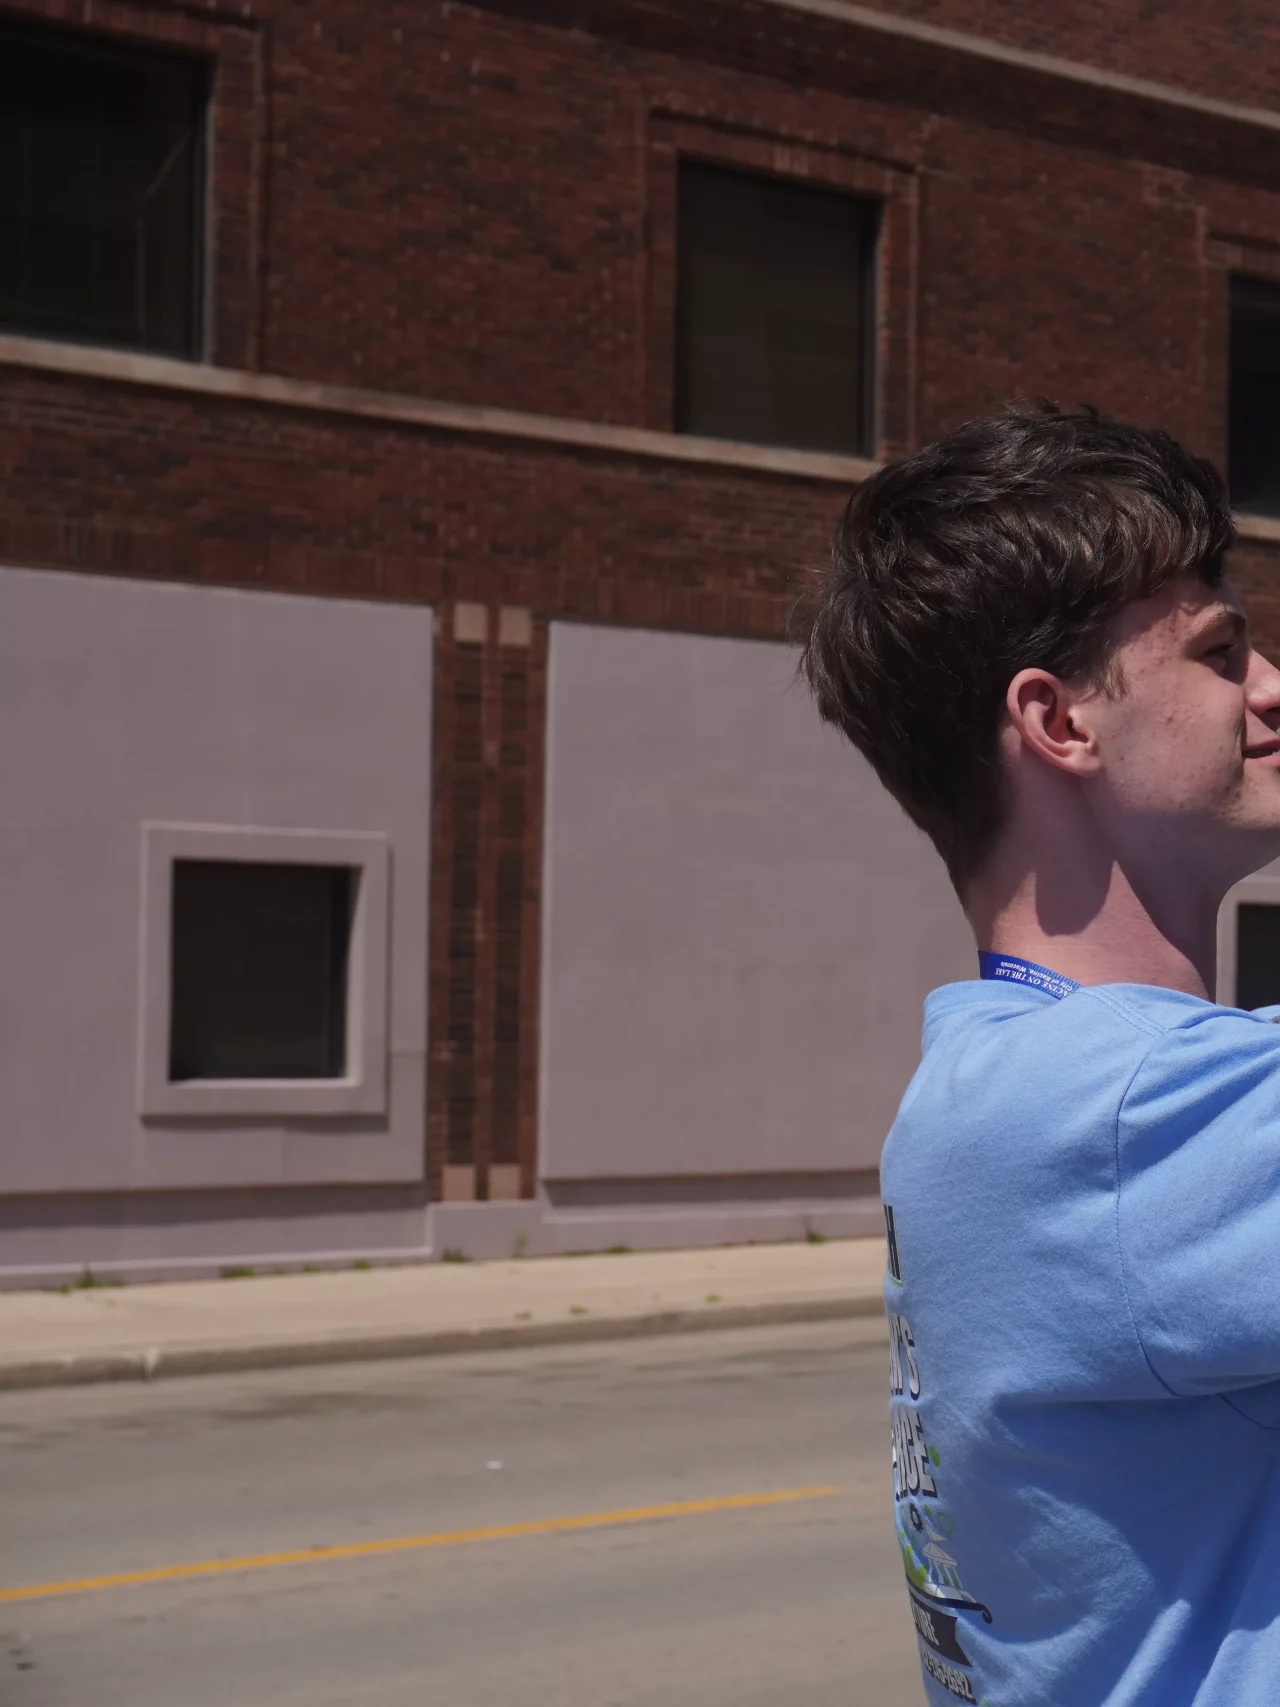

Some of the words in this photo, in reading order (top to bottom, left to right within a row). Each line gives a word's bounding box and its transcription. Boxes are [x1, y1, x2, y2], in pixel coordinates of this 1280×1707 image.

[995, 967, 1010, 977] LAKE
[1000, 961, 1027, 973] Wisconsin
[1010, 970, 1026, 981] THE
[1028, 968, 1051, 982] Racine,
[1027, 976, 1041, 985] ON
[1059, 982, 1073, 991] City
